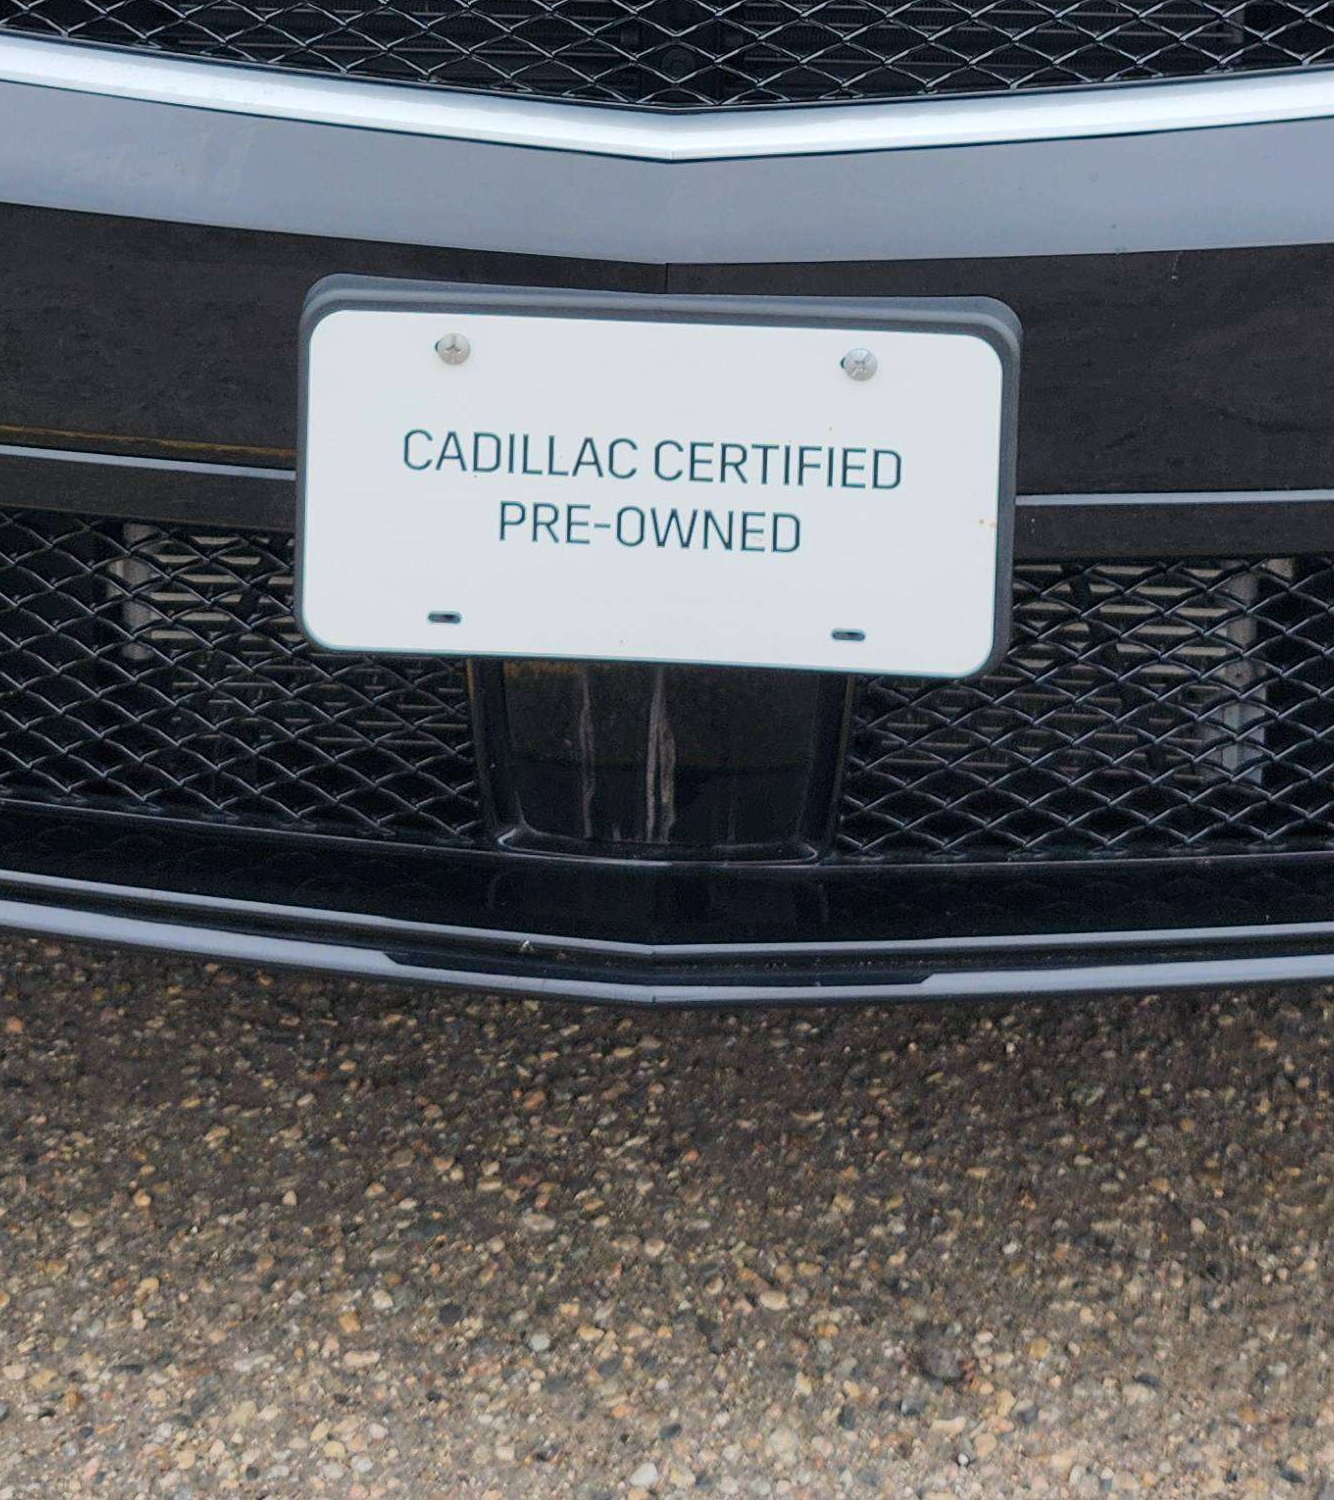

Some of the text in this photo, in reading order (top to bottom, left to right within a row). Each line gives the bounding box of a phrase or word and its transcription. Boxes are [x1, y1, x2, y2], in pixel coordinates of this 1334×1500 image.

[403, 429, 902, 490] CADILLAC CERTIFIED
[499, 500, 801, 553] PRE-OWNED
